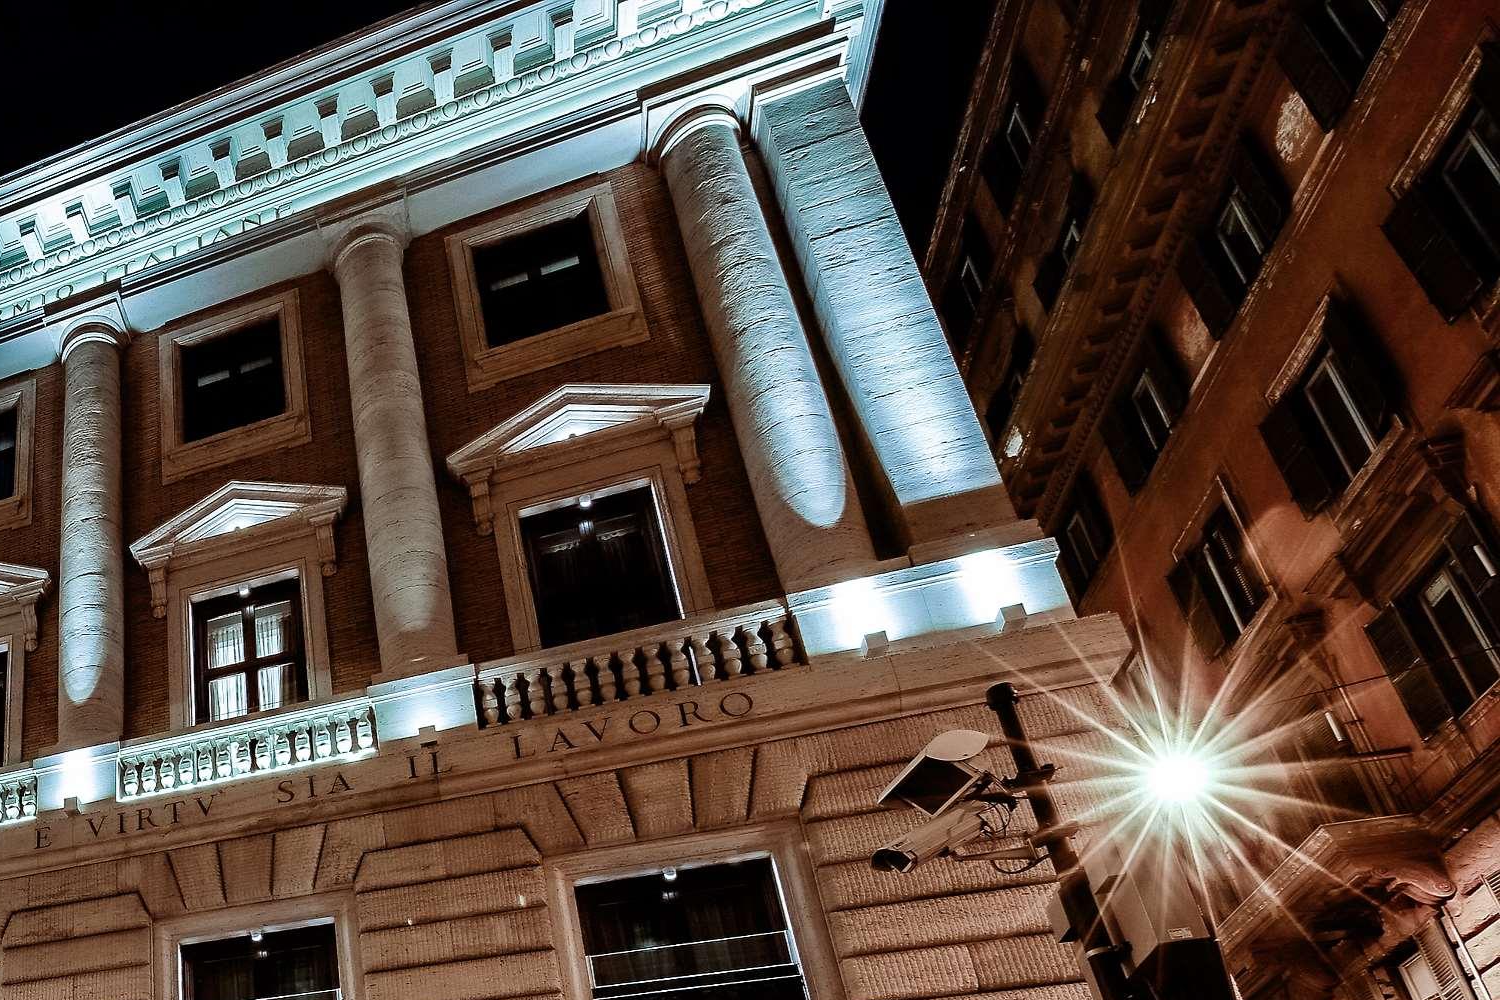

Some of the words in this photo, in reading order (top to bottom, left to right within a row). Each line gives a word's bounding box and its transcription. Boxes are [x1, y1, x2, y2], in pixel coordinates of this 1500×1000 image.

[34, 826, 52, 851] E
[277, 771, 354, 803] SIA
[408, 751, 453, 779] IL
[510, 692, 754, 760] LAVORO
